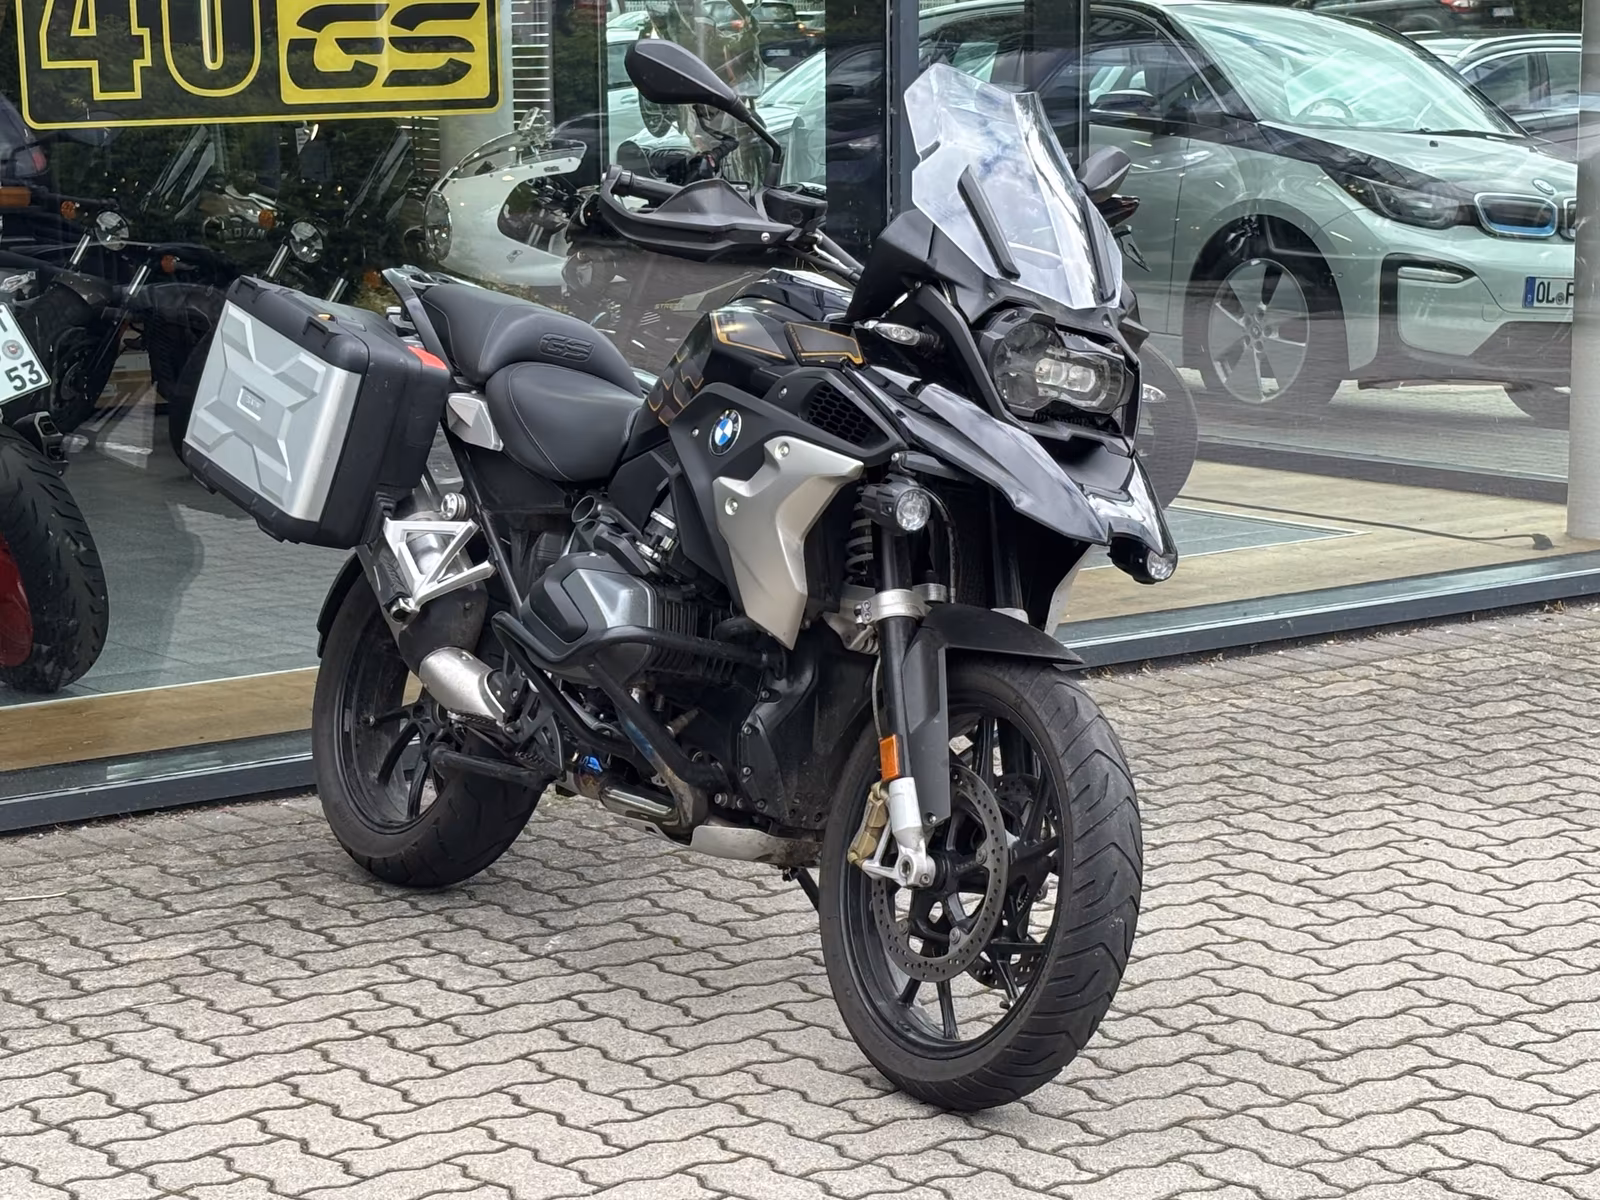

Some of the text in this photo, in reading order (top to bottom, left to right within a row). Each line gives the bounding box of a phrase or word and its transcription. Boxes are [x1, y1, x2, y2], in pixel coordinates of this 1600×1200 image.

[286, 2, 482, 90] GS
[540, 334, 592, 360] GS
[4, 360, 43, 391] 53
